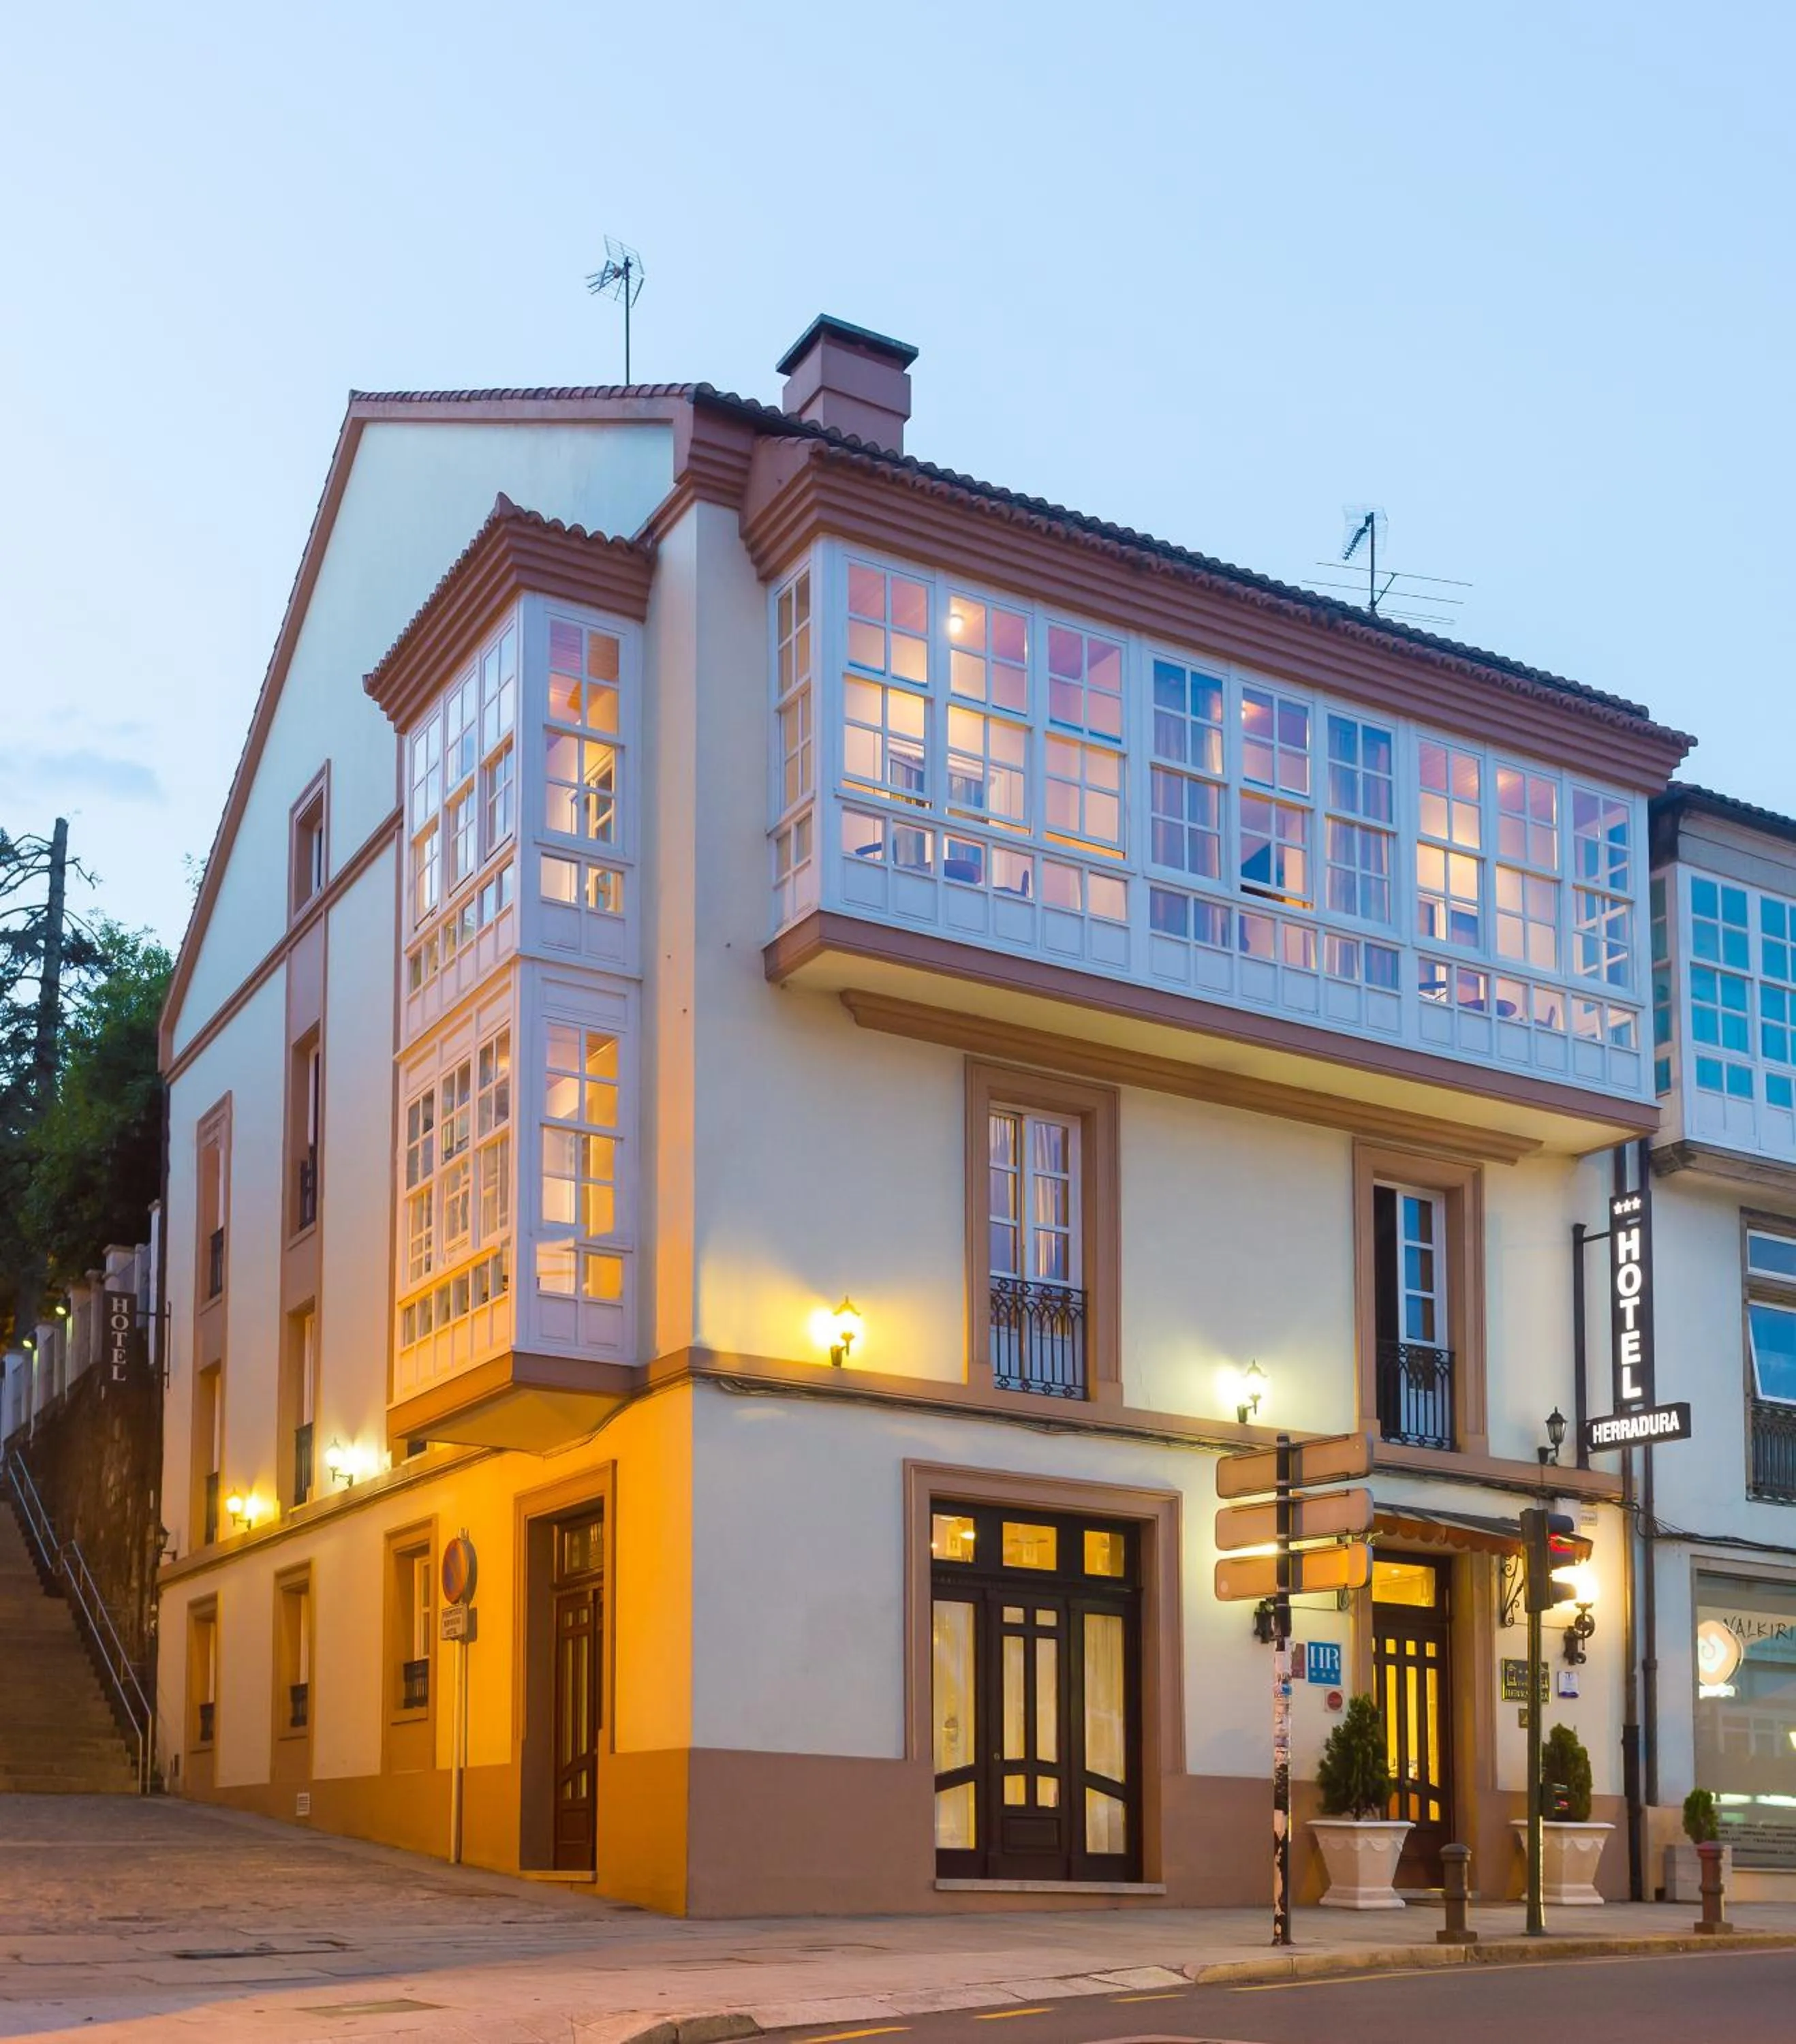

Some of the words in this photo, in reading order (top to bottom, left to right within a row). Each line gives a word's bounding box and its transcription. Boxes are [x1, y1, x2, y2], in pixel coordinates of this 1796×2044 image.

[112, 1297, 128, 1381] HOTEL
[1617, 1228, 1641, 1399] HOTEL
[1593, 1410, 1679, 1444] HERRADURA
